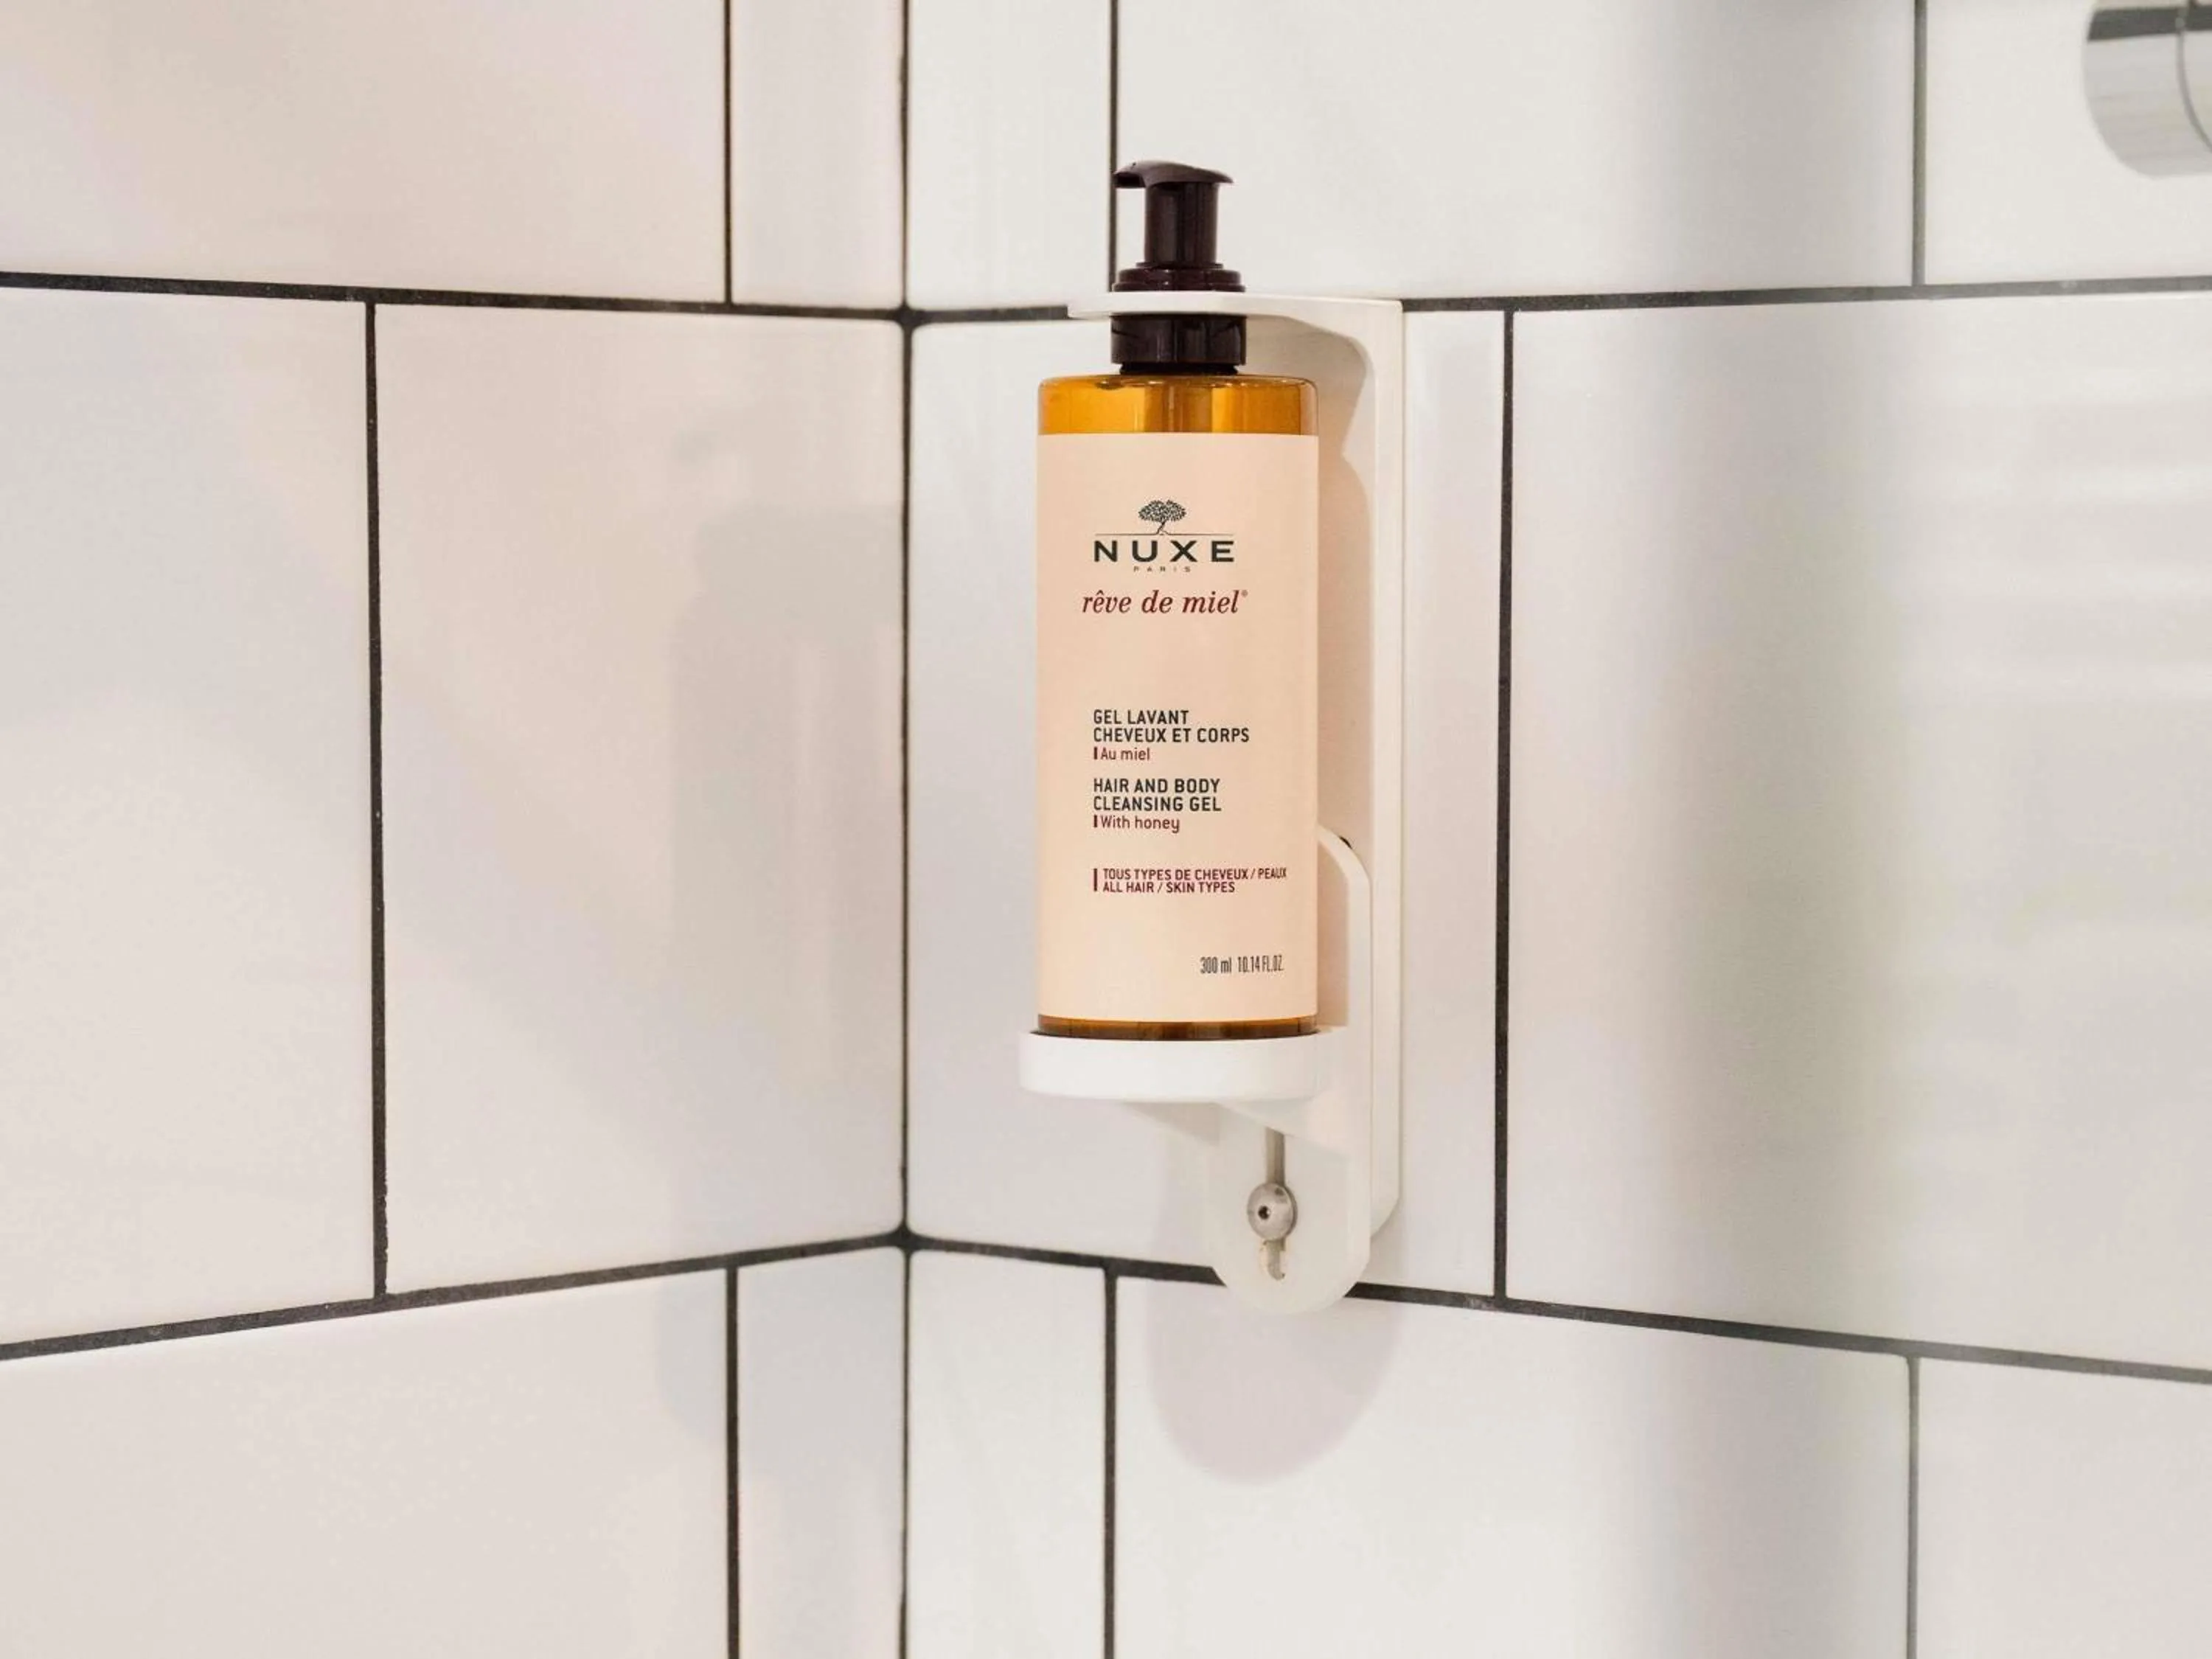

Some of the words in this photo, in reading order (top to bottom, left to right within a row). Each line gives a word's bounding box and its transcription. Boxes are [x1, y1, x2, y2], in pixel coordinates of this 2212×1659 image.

[1093, 540, 1235, 563] NUXE
[1082, 590, 1132, 613] rêve
[1141, 590, 1173, 613] de
[1093, 709, 1122, 725] GEL
[1127, 709, 1189, 725] LAVANT
[1093, 727, 1167, 743] CHEVEUX
[1172, 728, 1192, 743] ET
[1197, 727, 1250, 743] CORPS
[1100, 747, 1116, 760] Au
[1121, 747, 1150, 760] miel
[1093, 778, 1130, 793] HAIR
[1134, 778, 1168, 793] AND
[1175, 778, 1221, 793] BODY
[1093, 796, 1183, 812] CLEANSING
[1189, 796, 1222, 812] GEL
[1100, 815, 1130, 829] With
[1135, 815, 1180, 834] honey
[1103, 869, 1131, 880] TOUS
[1134, 869, 1172, 881] TYPES
[1175, 869, 1192, 880] DE
[1194, 869, 1248, 880] CHEVEUX
[1257, 867, 1287, 880] PEAUX
[1103, 881, 1123, 893] ALL
[1126, 881, 1155, 893] HAIR
[1166, 881, 1195, 893] SKIN
[1199, 881, 1236, 894] TYPES
[1200, 956, 1218, 974] 300
[1220, 956, 1232, 973] ml
[1238, 955, 1261, 973] 10.14
